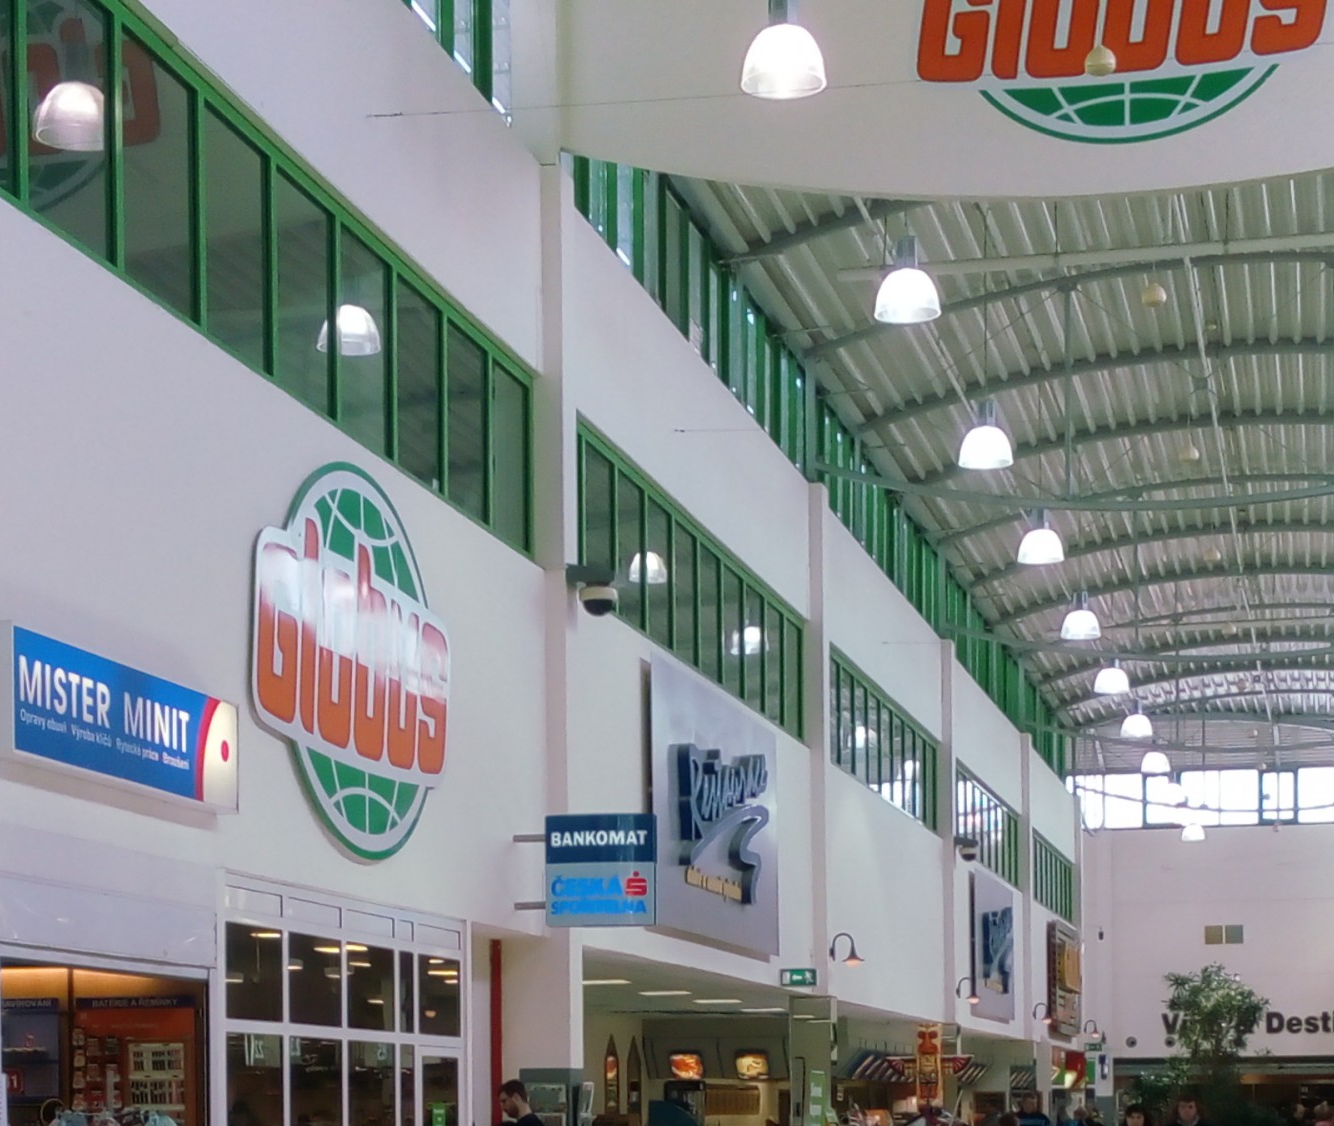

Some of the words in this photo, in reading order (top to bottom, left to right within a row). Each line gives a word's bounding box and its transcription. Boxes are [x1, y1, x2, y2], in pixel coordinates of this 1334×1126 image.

[257, 517, 448, 775] Globus
[19, 654, 111, 728] MISTER
[123, 692, 191, 753] MINIT
[19, 709, 46, 730] Opravy
[551, 830, 648, 847] BANKOMAT
